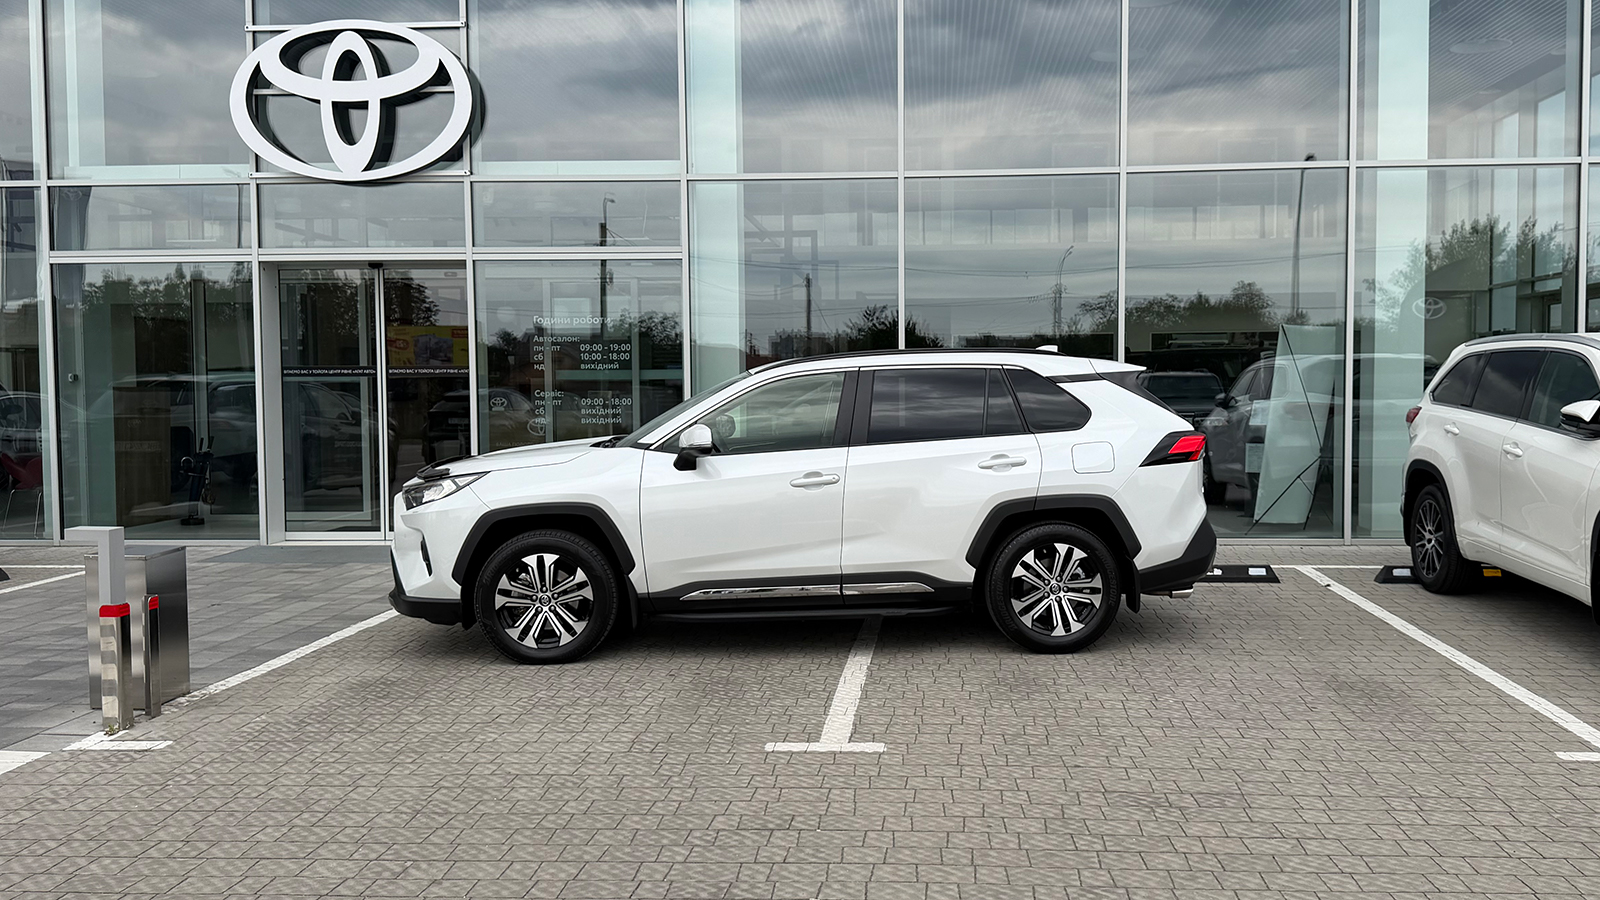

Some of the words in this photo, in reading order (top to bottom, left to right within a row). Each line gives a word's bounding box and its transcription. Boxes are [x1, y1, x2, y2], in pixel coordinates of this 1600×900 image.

[533, 315, 571, 326] Години
[580, 343, 603, 351] 09:00
[609, 343, 631, 351] 19:00
[533, 353, 544, 361] сб
[580, 362, 619, 370] вихідний
[534, 389, 564, 398] Сервіс:
[534, 407, 545, 415] сб
[581, 407, 622, 415] вихідний
[581, 416, 622, 424] вихідний
